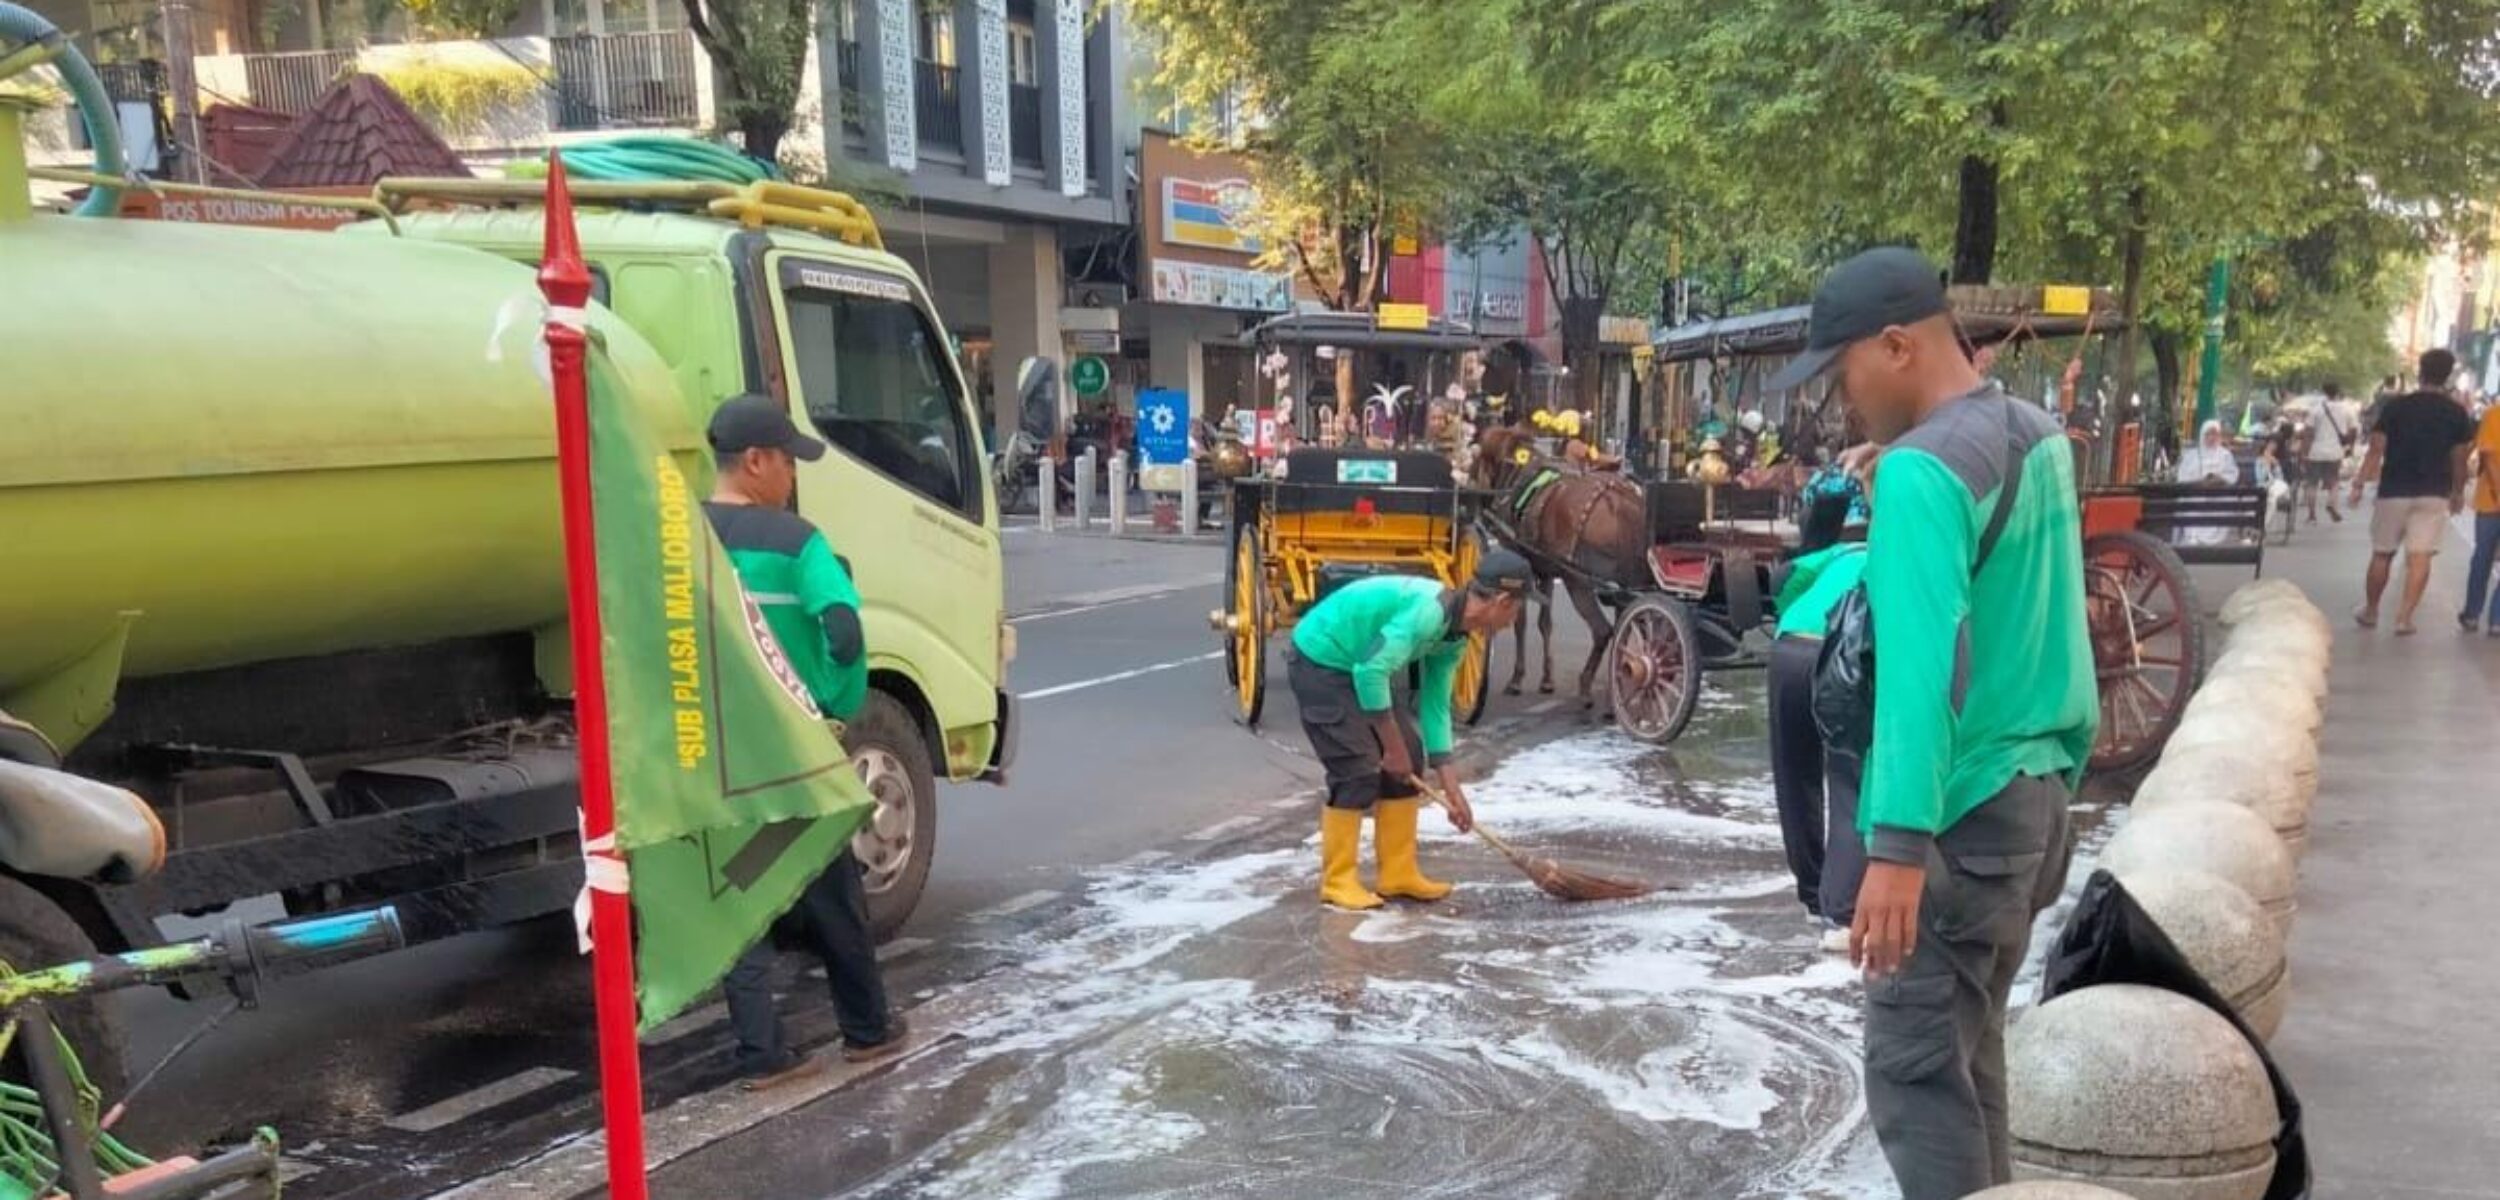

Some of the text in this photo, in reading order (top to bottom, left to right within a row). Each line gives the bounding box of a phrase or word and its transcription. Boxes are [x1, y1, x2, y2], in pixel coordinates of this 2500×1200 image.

[161, 201, 198, 220] POS
[201, 200, 285, 221] TOURISM
[666, 626, 701, 702] PLASA
